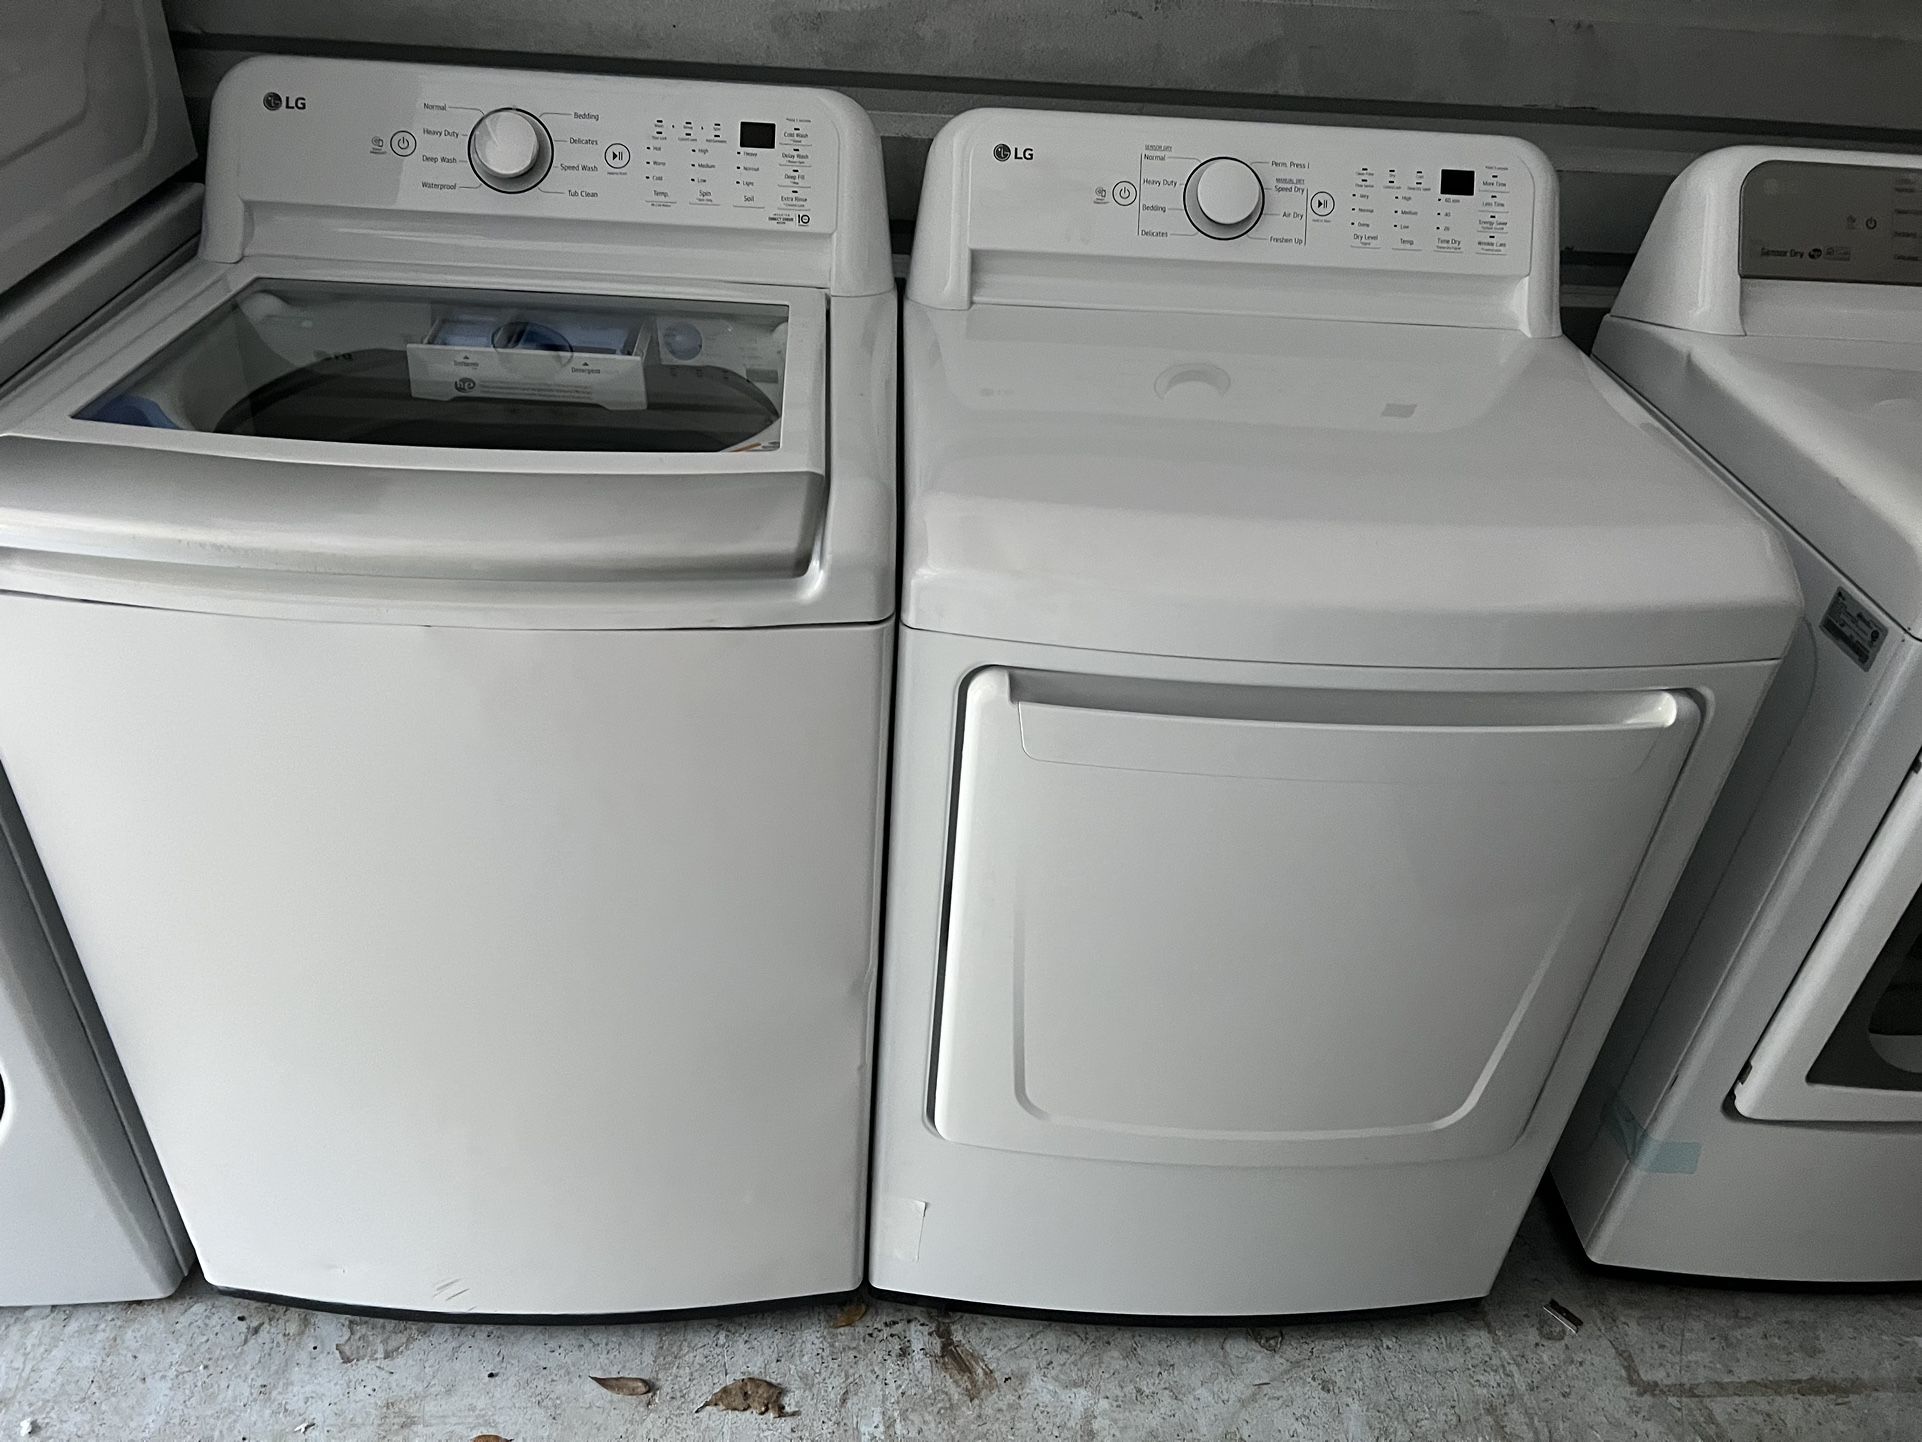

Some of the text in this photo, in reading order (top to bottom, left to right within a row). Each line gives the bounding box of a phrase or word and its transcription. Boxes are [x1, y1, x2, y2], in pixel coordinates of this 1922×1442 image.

[285, 96, 307, 110] LG
[423, 102, 447, 111] Normal
[573, 111, 600, 122] Bedding
[423, 128, 459, 139] Heavy Duty
[569, 137, 599, 145] Delicates
[1014, 148, 1034, 161] LG
[422, 155, 457, 164] Deep Wash
[560, 164, 599, 172] Speed Wash
[422, 181, 457, 190] Waterproof
[1143, 178, 1177, 188] Heavy Duty
[580, 190, 599, 198] Clean
[699, 190, 712, 198] Spin
[1274, 185, 1305, 196] Speed Dry
[1142, 204, 1167, 214] Bedding
[1293, 212, 1304, 221] Dry
[1141, 230, 1168, 238] Delicates
[1353, 234, 1364, 242] Dry
[1270, 236, 1303, 246] Freshen Up
[1451, 238, 1461, 246] Dry
